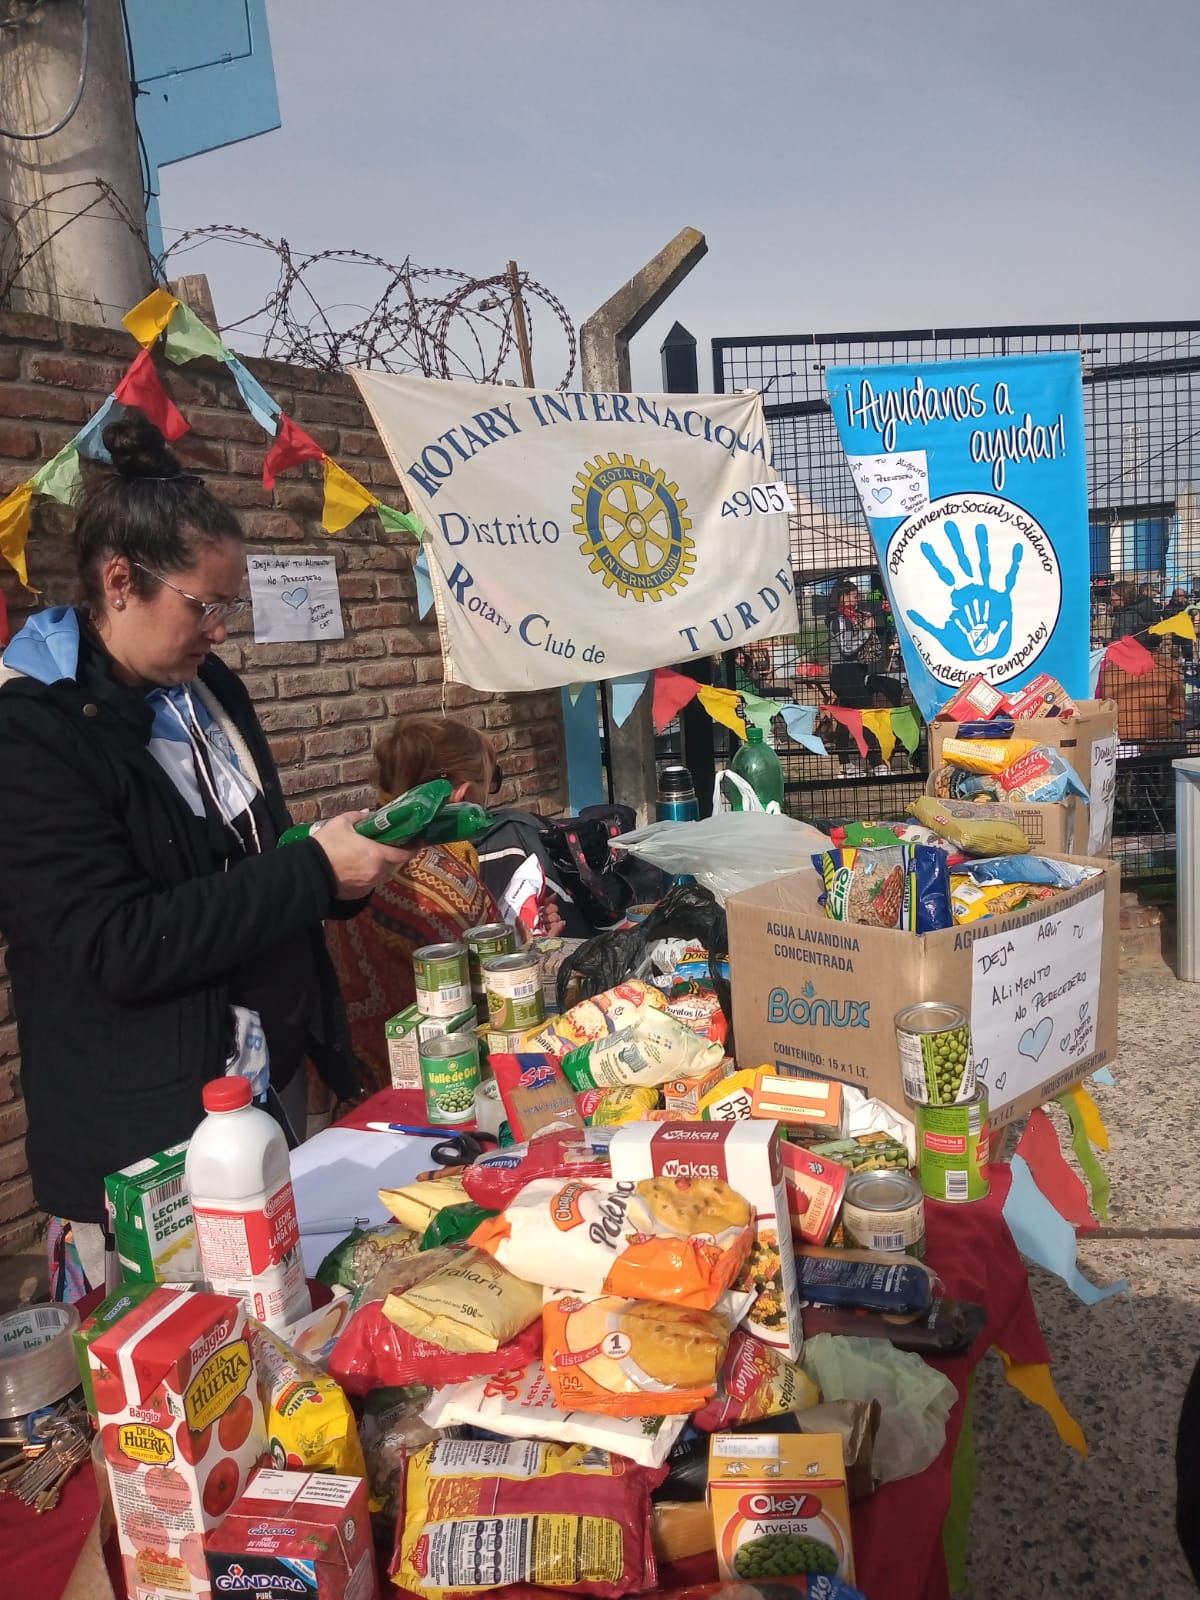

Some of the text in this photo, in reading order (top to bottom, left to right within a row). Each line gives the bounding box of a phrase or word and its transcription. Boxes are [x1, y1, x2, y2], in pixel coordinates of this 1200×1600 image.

[993, 382, 1014, 415] a
[406, 402, 523, 499] ROTARY
[970, 413, 1067, 491] ayudar!
[599, 468, 651, 486] ROTARY
[438, 484, 785, 547] Distrito 4905
[888, 502, 961, 576] Departamento
[1011, 514, 1054, 576] Solidario
[602, 551, 681, 589] INTERNATIONAL
[447, 562, 513, 634] Rotary
[518, 613, 576, 658] Club
[582, 636, 606, 665] de
[986, 621, 1049, 680] Temperley
[766, 921, 860, 953] AGUA LAVANDINA
[977, 941, 1016, 975] DEJA
[1072, 924, 1084, 939] TU
[774, 943, 854, 973] CONCENTRADA
[767, 986, 871, 1029] Bonux
[1014, 971, 1087, 1022] NO PERECEDERO
[428, 1071, 451, 1084] Valle
[451, 1069, 464, 1081] de
[773, 1042, 869, 1080] CONTENIDO: 15 x 1 LT.
[1040, 1050, 1107, 1098] INDUSTRIA ARGENTINA
[661, 1159, 719, 1178] Wakas
[152, 1195, 190, 1222] LECHE
[153, 1214, 174, 1231] SEMI
[274, 1208, 292, 1231] LECHE
[155, 1214, 194, 1242] DESCR
[268, 1226, 289, 1250] LARGA
[440, 1267, 503, 1297] Tallarin
[191, 1321, 228, 1366] Baggio
[586, 1347, 599, 1360] en
[610, 1334, 622, 1350] 1
[189, 1352, 248, 1416] HUERTA
[202, 1355, 226, 1386] DE LA
[779, 1362, 798, 1410] Lentejas
[521, 1384, 541, 1408] Leche
[129, 1406, 160, 1423] Baggio
[124, 1431, 171, 1456] HUERTA
[136, 1426, 155, 1439] DE LA
[753, 1521, 808, 1537] Arvejas
